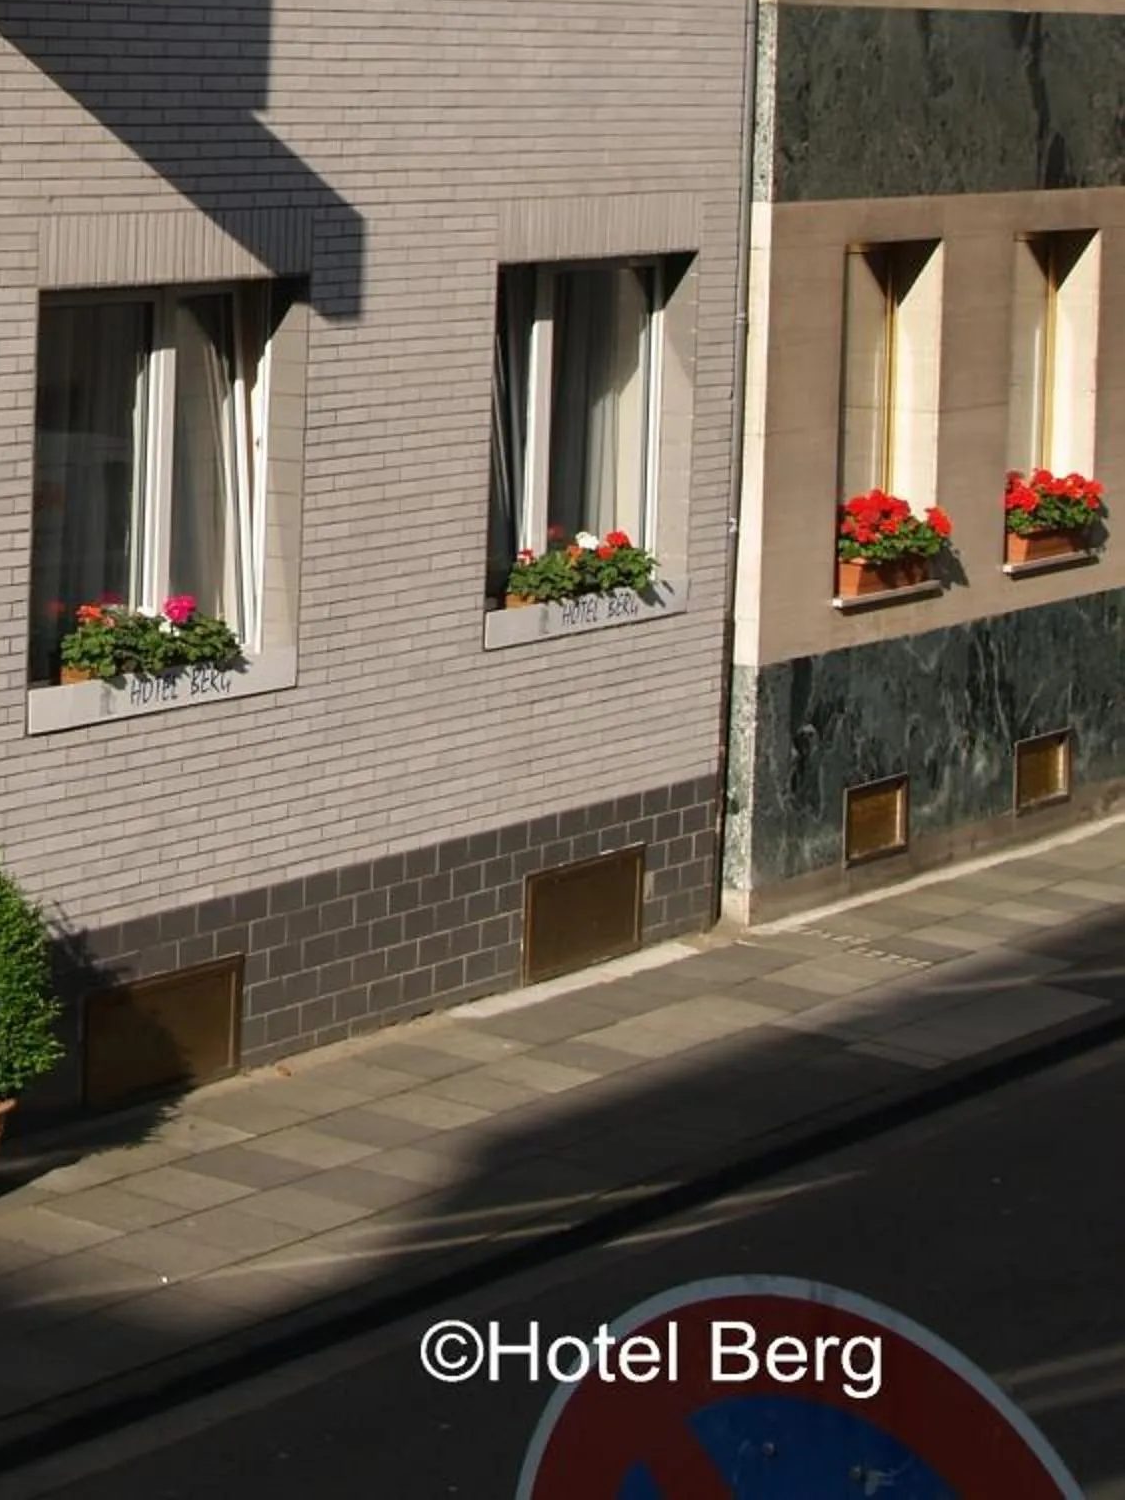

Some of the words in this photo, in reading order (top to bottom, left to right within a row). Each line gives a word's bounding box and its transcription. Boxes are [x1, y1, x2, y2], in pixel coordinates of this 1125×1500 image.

[561, 599, 599, 626] HOTEL
[607, 592, 638, 619] BERG
[130, 673, 179, 705] HOTEL
[189, 666, 231, 695] BERG
